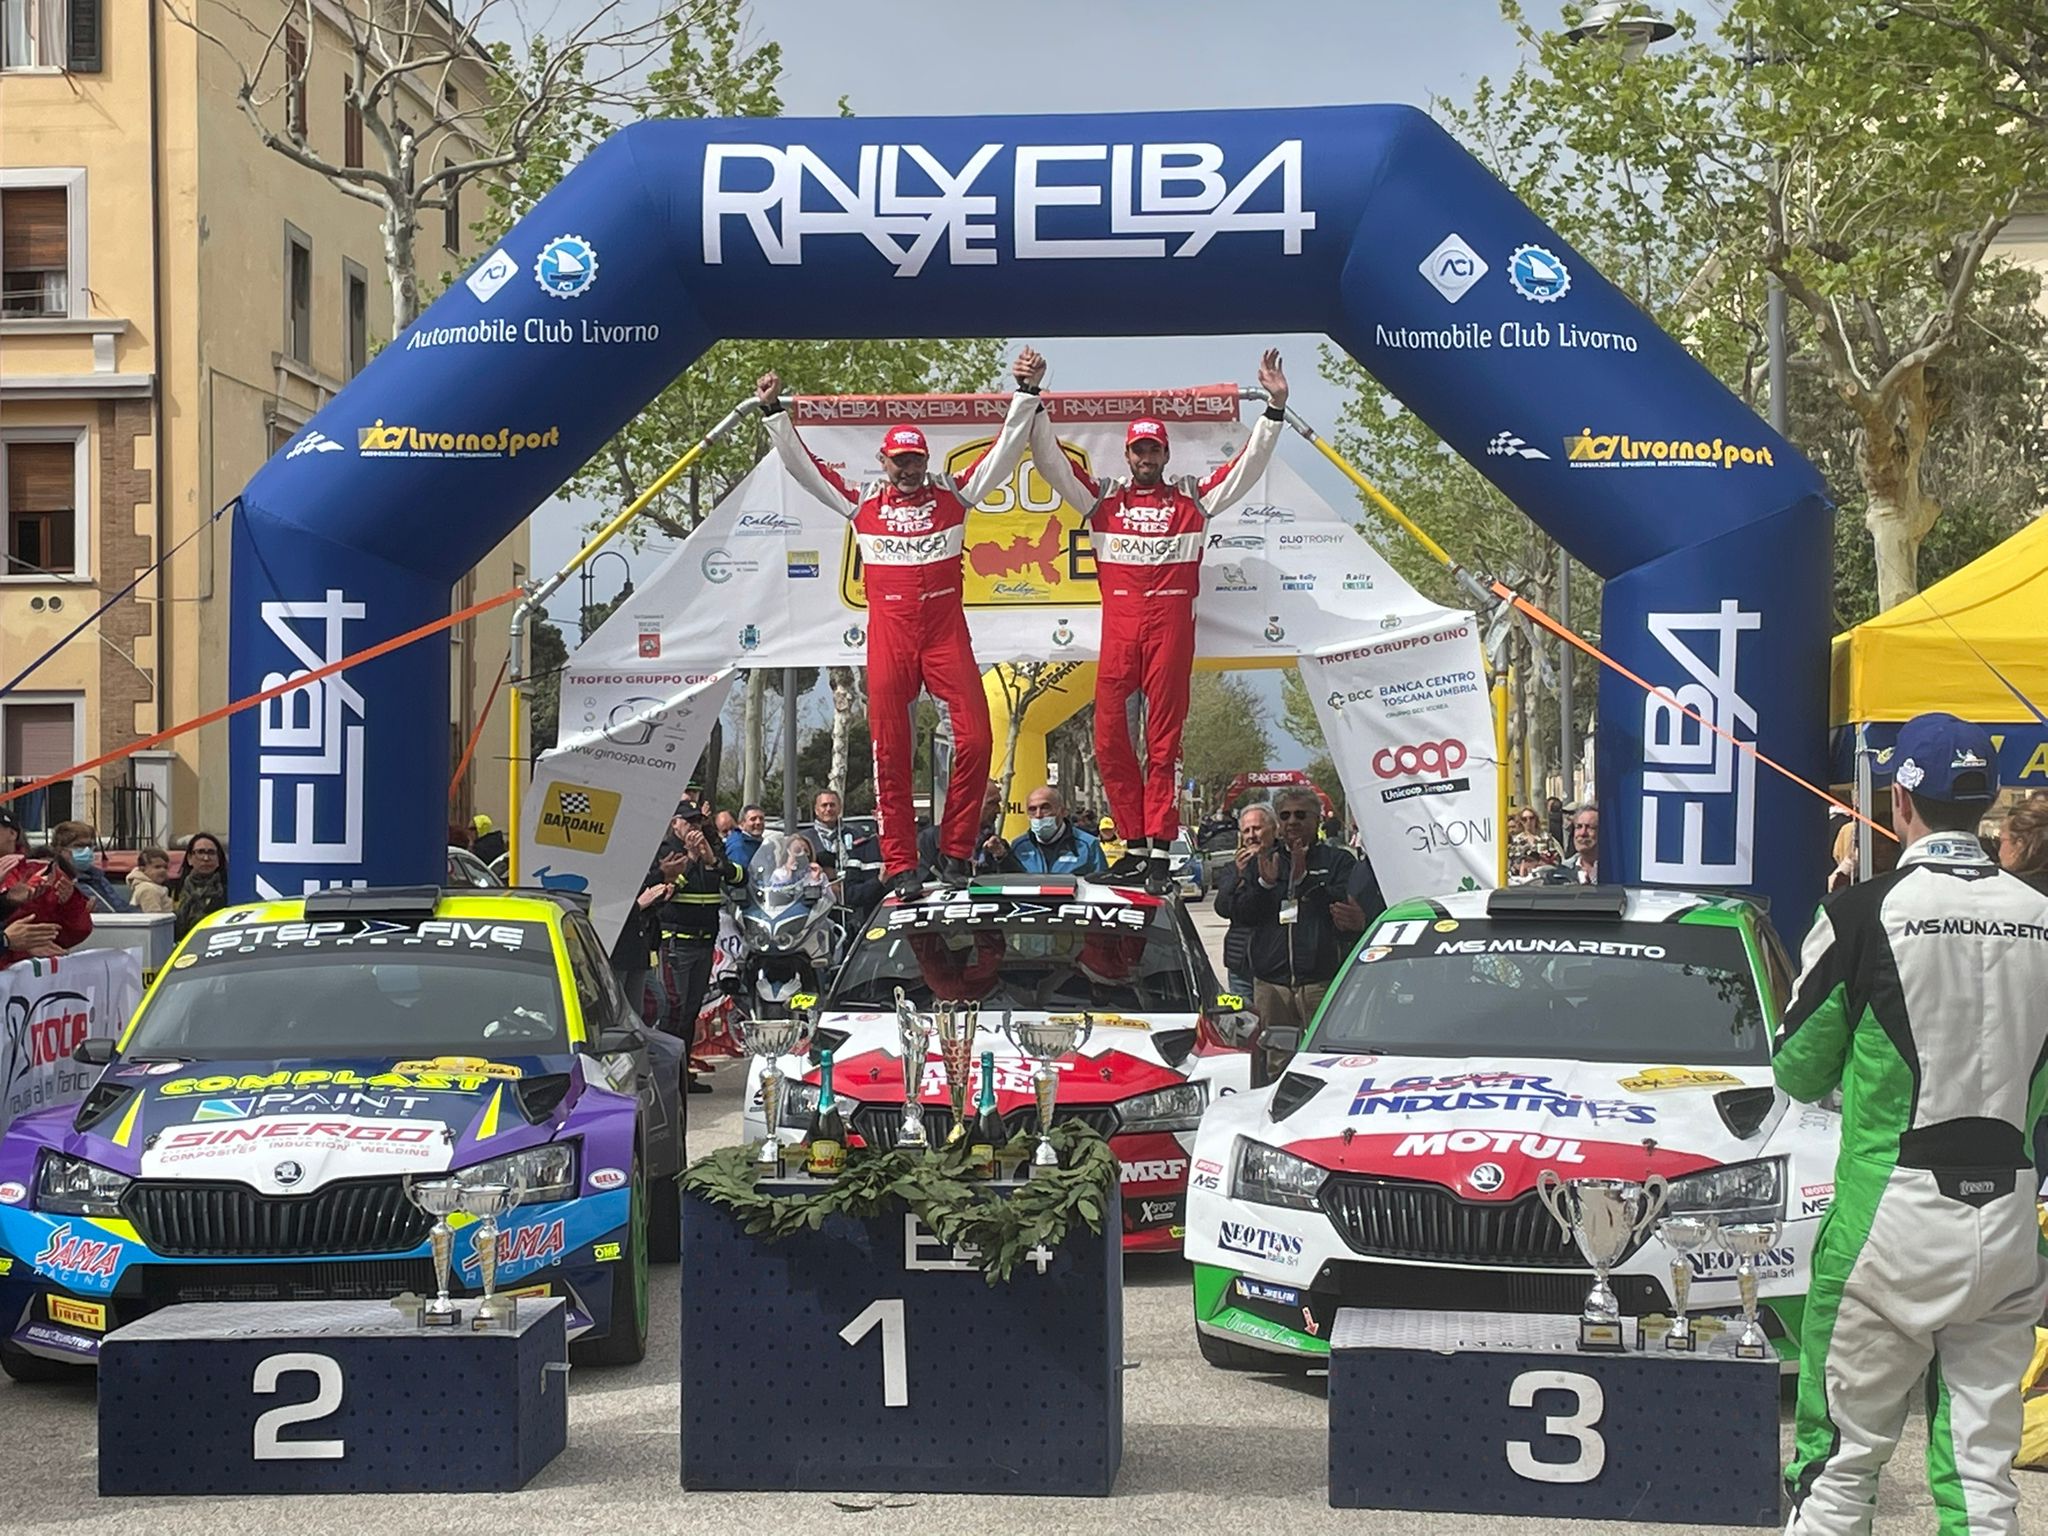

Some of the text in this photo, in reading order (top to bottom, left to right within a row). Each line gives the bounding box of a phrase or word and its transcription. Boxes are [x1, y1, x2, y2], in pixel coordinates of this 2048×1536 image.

[703, 140, 1316, 277] RALLYE ELBA
[406, 317, 660, 351] Automobile Club Livorno
[1376, 321, 1639, 353] Automobile Club Livorno
[886, 519, 934, 533] TYRES
[1122, 518, 1169, 533] TYRES
[1317, 627, 1469, 666] TROFEO GRUPPO GINO
[569, 674, 719, 685] TROFEO GRUPPO GINO
[1347, 671, 1477, 703] BCC BANCA CENTRO
[1382, 683, 1478, 707] TOSCANA UMBRIA
[259, 588, 367, 864] ELBA
[1640, 599, 1762, 886] ELBA
[1372, 738, 1467, 779] coop
[543, 812, 606, 835] BARDAHL
[889, 902, 1145, 925] STEP FIVE
[208, 921, 525, 950] STEP FIVE
[1388, 922, 1410, 944] 1
[160, 1069, 490, 1095] COMPLAST
[257, 1092, 430, 1110] PAINT
[165, 1122, 434, 1150] SINERGO
[1393, 1130, 1587, 1164] MOTUL
[160, 1144, 257, 1164] COMPOSITES
[268, 1141, 349, 1152] INDUCTION
[360, 1145, 430, 1157] WELDING
[595, 1172, 621, 1183] BELL
[1119, 1158, 1187, 1183] MRF
[1193, 1173, 1220, 1190] MS
[36, 1222, 123, 1278] SAMA
[462, 1218, 566, 1272] AMA
[34, 1265, 111, 1289] RACING
[465, 1257, 562, 1282] RCING
[1780, 1266, 1795, 1279] Srl
[838, 1298, 909, 1408] 1
[252, 1352, 345, 1460] 2
[1506, 1369, 1606, 1484] 3
